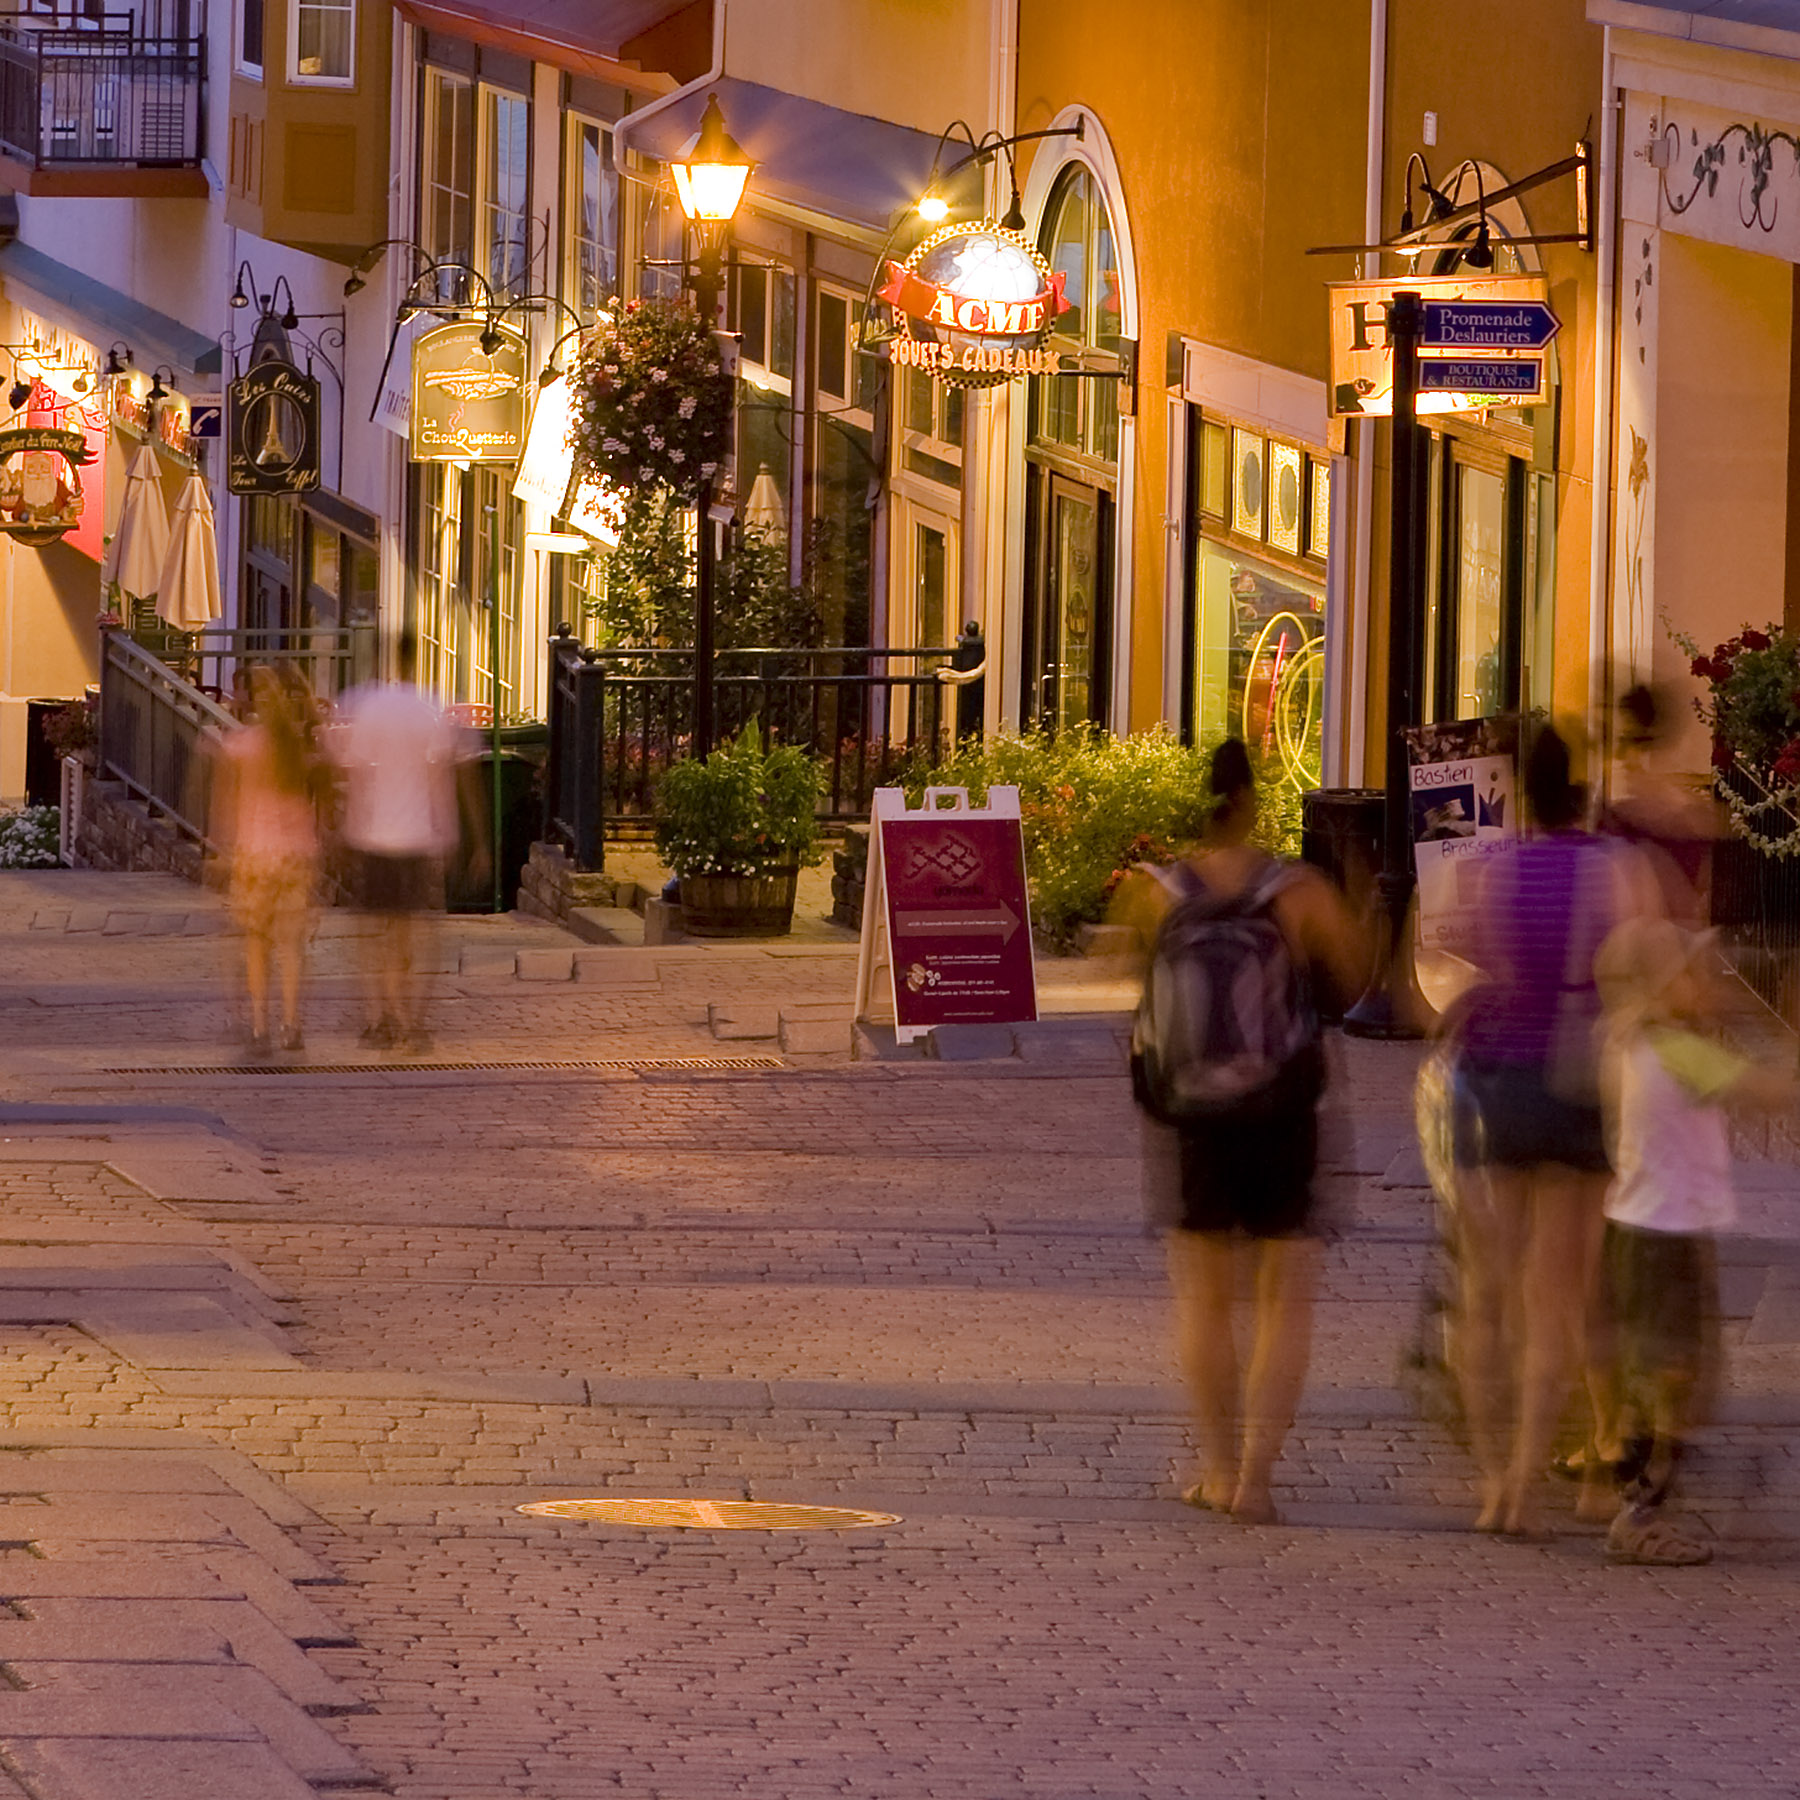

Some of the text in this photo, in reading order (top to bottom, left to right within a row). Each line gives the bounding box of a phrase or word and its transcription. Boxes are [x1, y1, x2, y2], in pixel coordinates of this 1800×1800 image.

[924, 290, 1046, 334] ACME
[1439, 308, 1533, 327] Promenade
[1439, 326, 1532, 343] Deslauriers
[889, 338, 1063, 376] JOUETS CADEAUX
[1448, 364, 1518, 376] BOUTIQUES
[1426, 375, 1531, 388] & RESTAURANTS
[1413, 764, 1474, 787] Bastien
